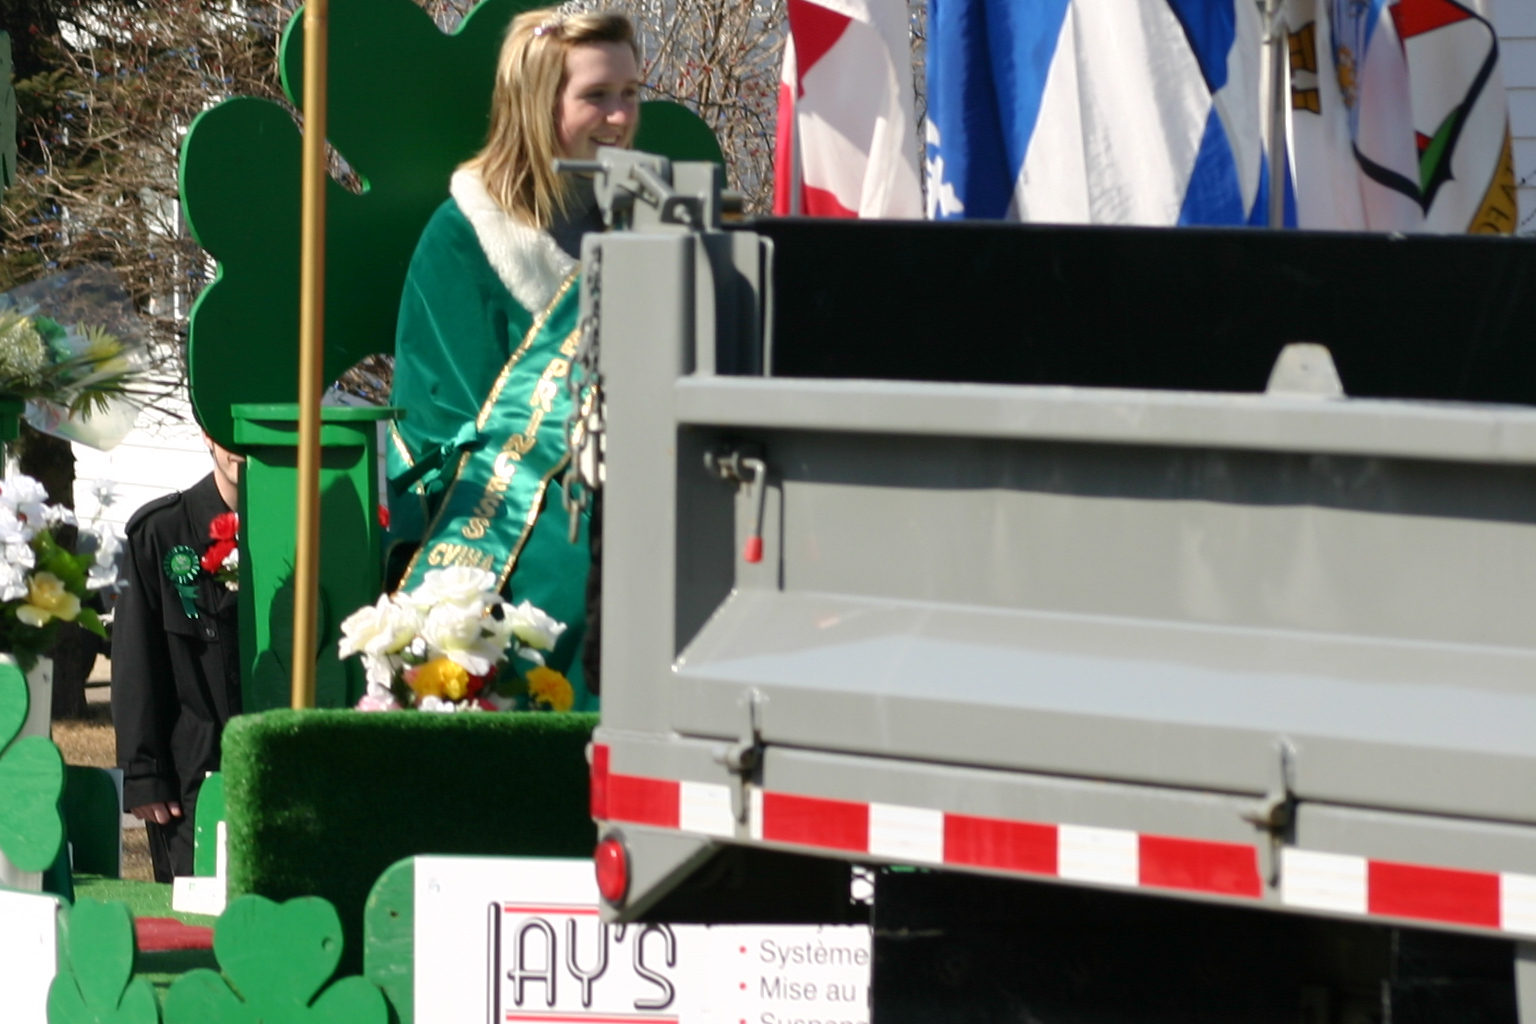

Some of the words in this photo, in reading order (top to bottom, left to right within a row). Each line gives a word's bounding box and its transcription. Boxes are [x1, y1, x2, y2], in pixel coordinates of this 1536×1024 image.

[759, 939, 869, 970] Système
[760, 975, 818, 1001] Mise
[825, 982, 857, 1002] au
